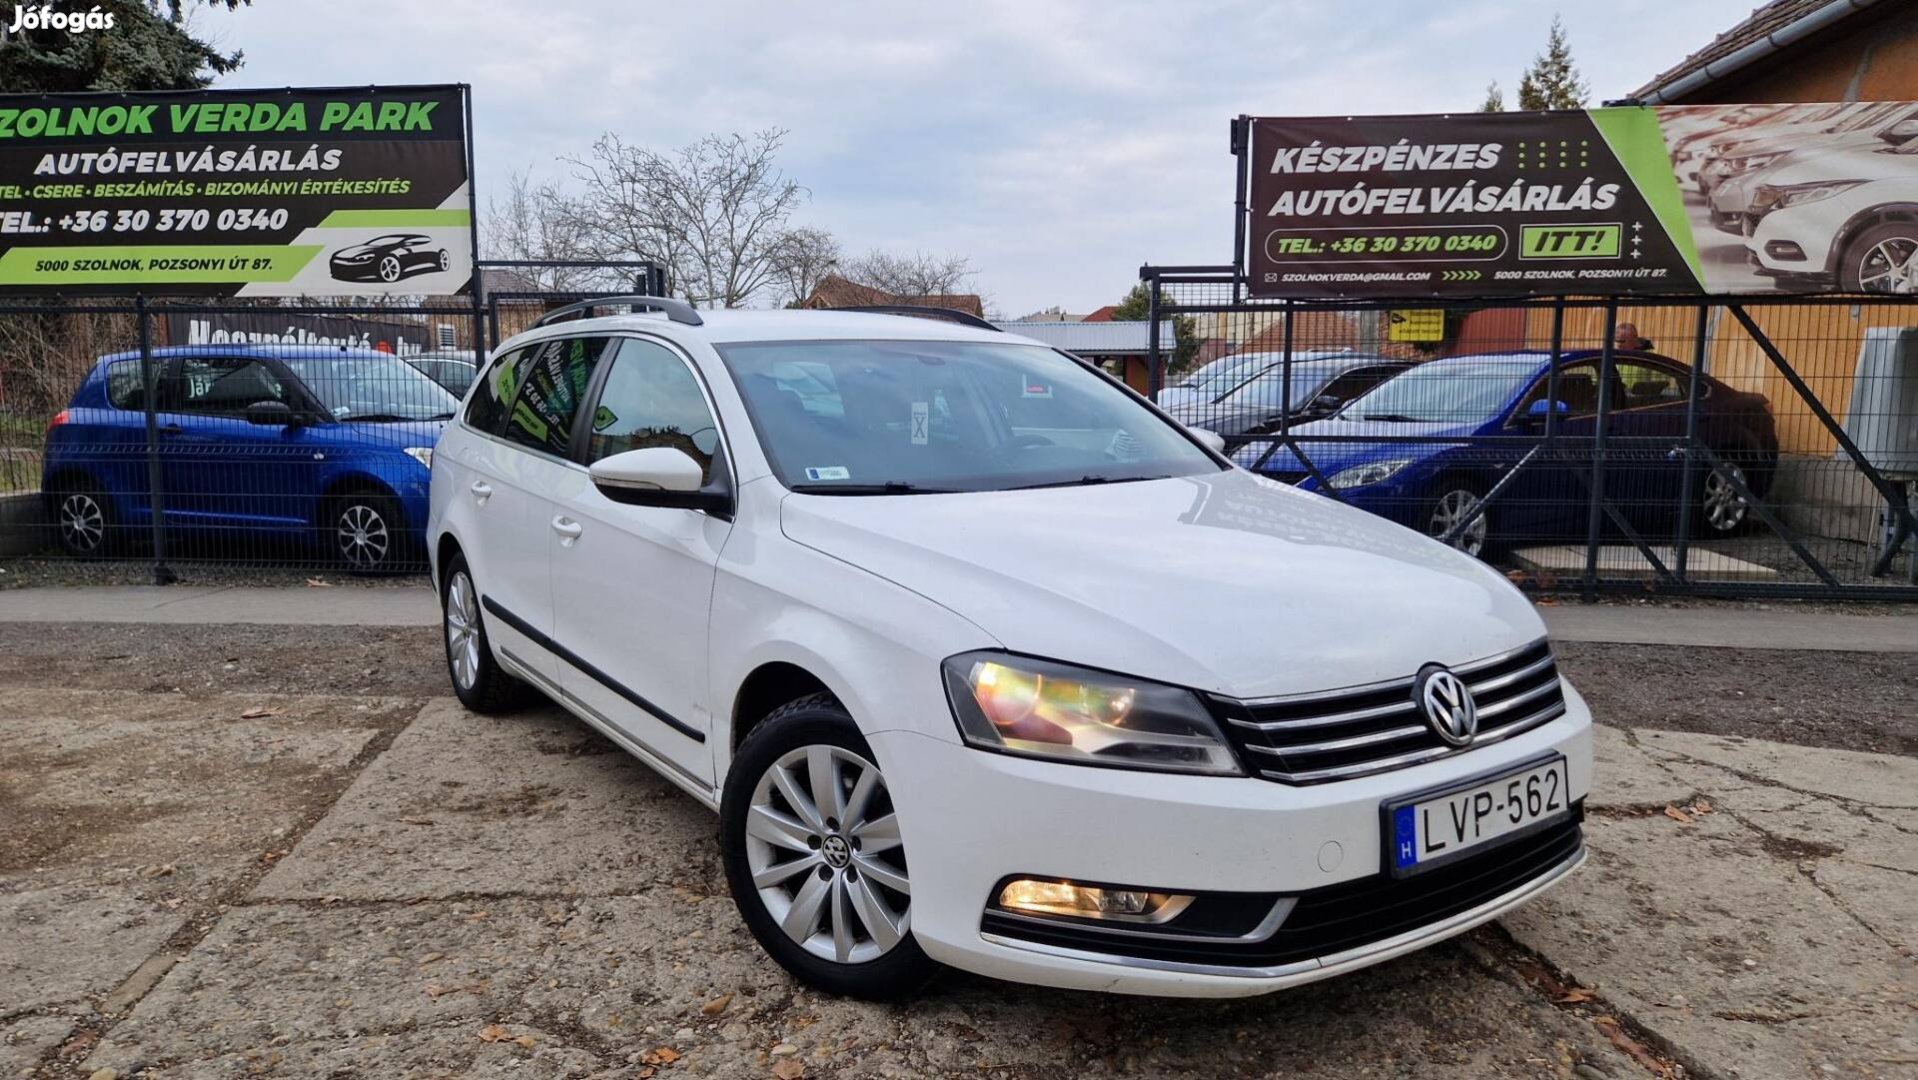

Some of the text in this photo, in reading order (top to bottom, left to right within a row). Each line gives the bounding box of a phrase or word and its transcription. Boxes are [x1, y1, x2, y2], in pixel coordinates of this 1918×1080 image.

[169, 102, 308, 134] VERDA
[319, 101, 440, 132] PARK
[33, 144, 343, 175] AUTÓFELVÁSÁRLÁS
[1270, 138, 1503, 174] KÉSZPÉNZES
[33, 184, 84, 199] CSERE
[94, 180, 195, 198] BESZÁMÍTÁS
[205, 180, 298, 197] BIZOMÁNYI
[300, 177, 411, 195] ÉRTÉKESÍTÉS
[1267, 176, 1621, 217] AUTÓFELVÁSÁRLÁS
[59, 210, 109, 232] +36
[113, 209, 150, 232] 30
[155, 208, 210, 232] 370
[217, 208, 289, 231] 0340
[1278, 234, 1498, 254] TEL.: +36 30 370 0340
[1534, 230, 1606, 252] ITT!
[35, 255, 273, 272] 5000 SZOLNOK, POZSONYI ÚT 87.
[1494, 271, 1522, 280] 5000
[1578, 268, 1634, 279] POZSONYI
[1635, 266, 1651, 278] ÚT
[1281, 271, 1432, 283] SZOLNOKVERDA@GMAIL.COM
[1423, 768, 1560, 854] LVP-562
[1401, 840, 1412, 860] H
